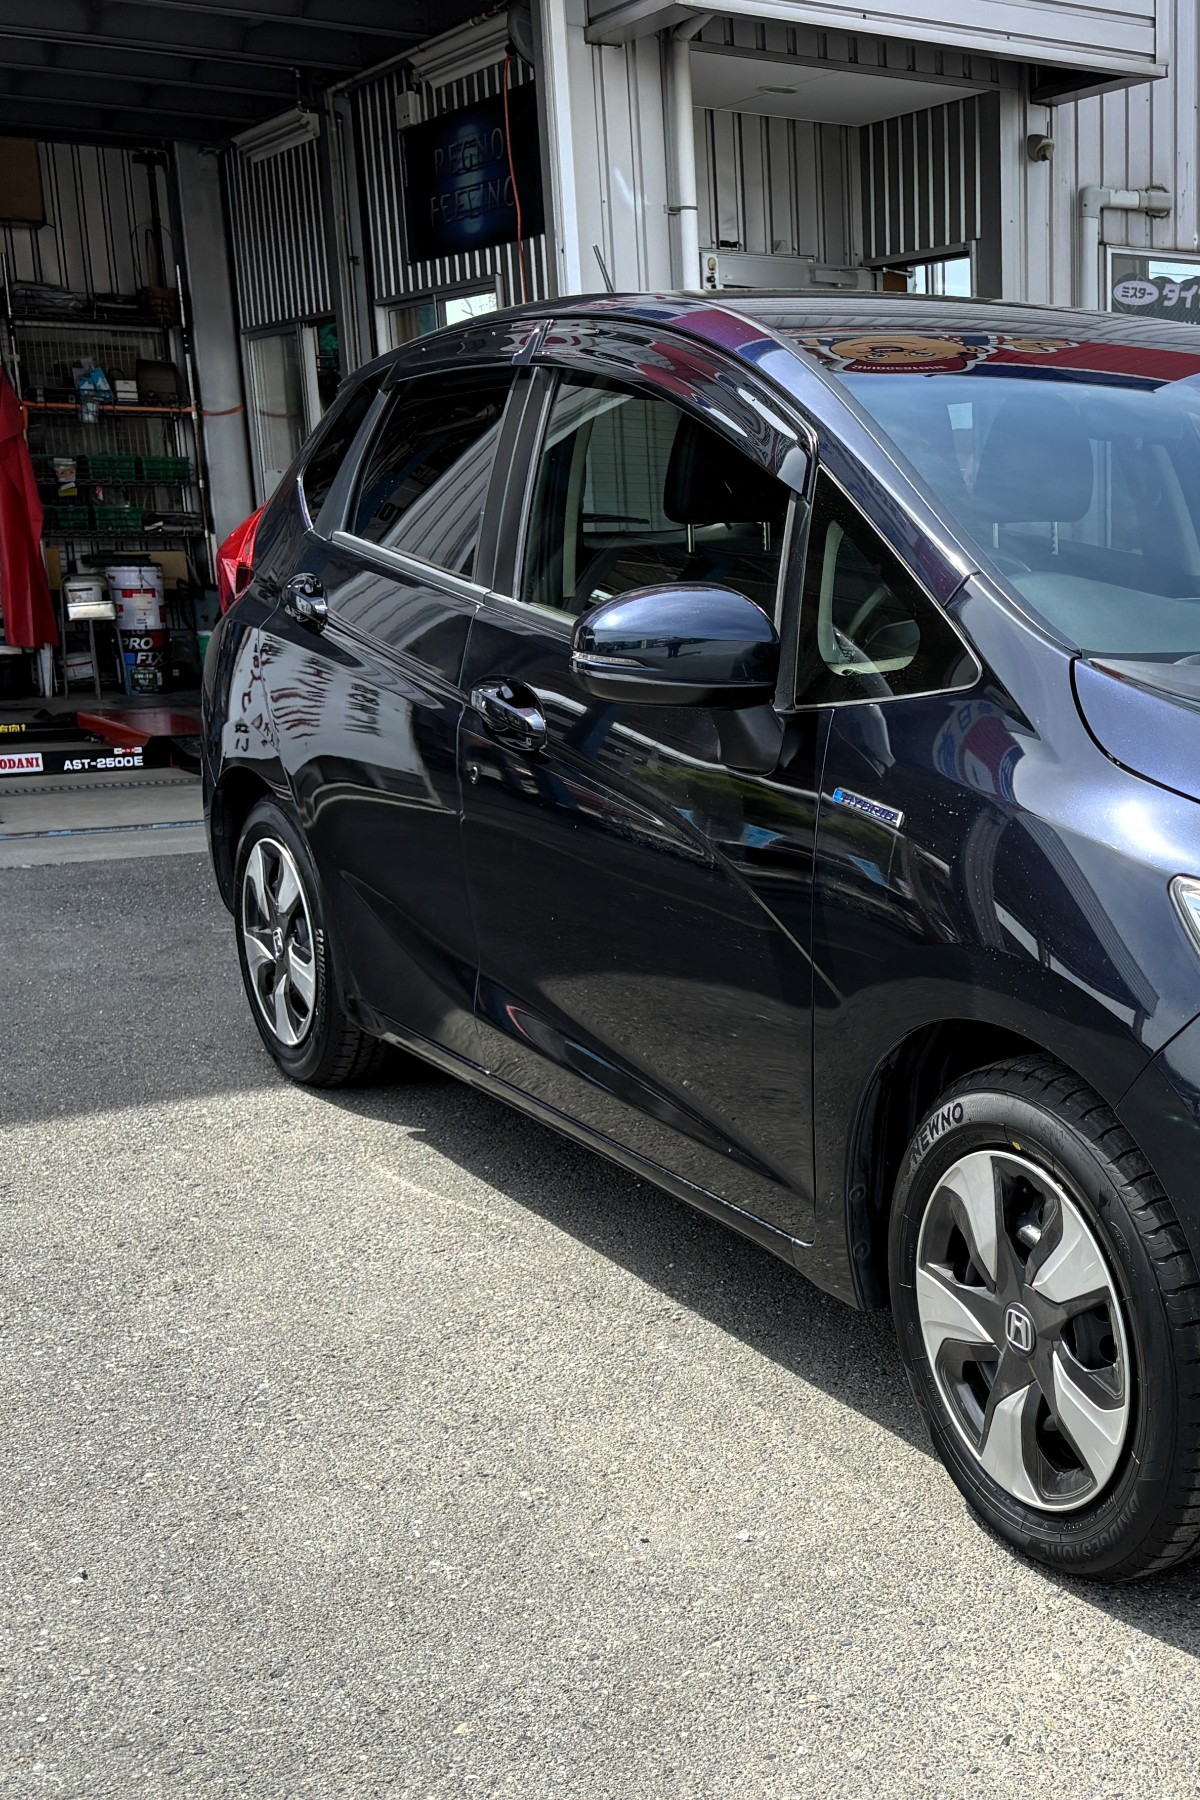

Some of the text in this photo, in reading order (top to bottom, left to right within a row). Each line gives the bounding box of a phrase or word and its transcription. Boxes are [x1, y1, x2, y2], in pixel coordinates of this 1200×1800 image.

[1121, 286, 1154, 299] ミスター
[121, 637, 154, 650] PRO
[137, 652, 164, 665] FIX
[64, 756, 144, 770] AST-2500E
[909, 1102, 964, 1165] NEWNO
